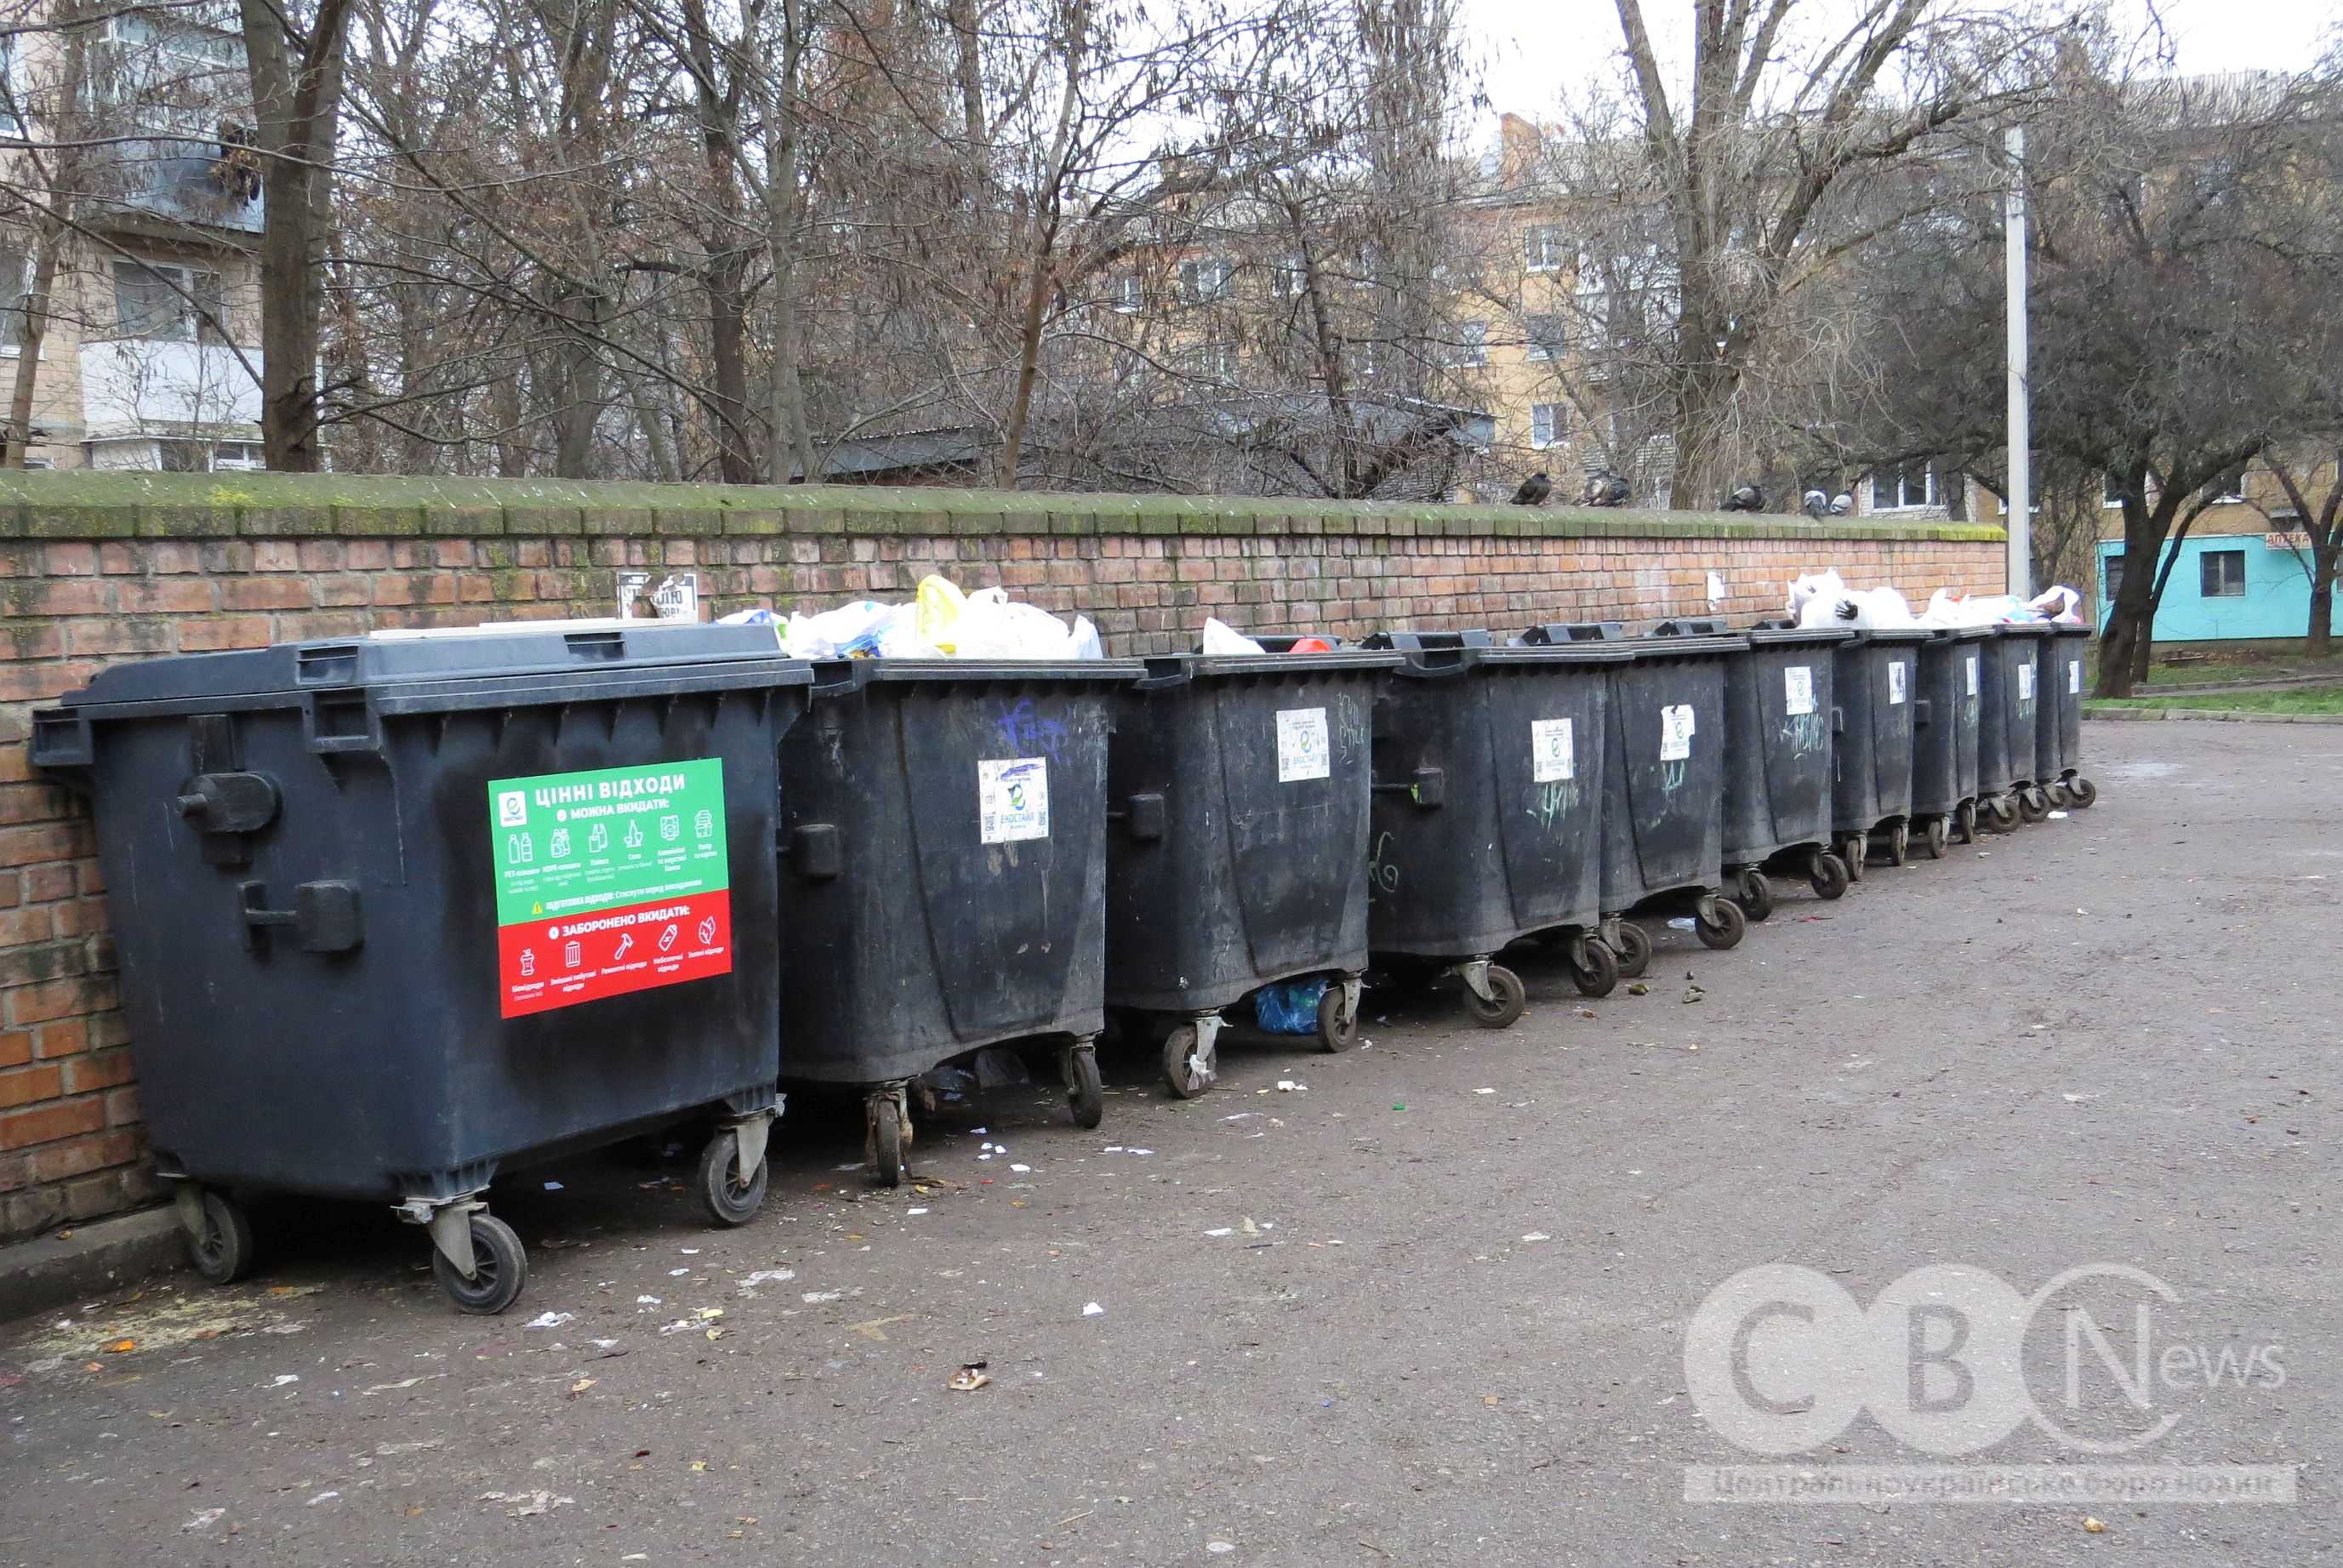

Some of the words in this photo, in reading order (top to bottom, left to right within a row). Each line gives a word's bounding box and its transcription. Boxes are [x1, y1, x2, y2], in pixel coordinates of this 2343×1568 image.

[535, 784, 593, 807] ЦІННІ
[598, 773, 686, 799] ВІДХОДИ
[571, 804, 615, 819] МОЖНА
[617, 798, 670, 814] ВКИДАТИ:
[562, 915, 636, 937] ЗАБОРОНЕНО
[637, 904, 691, 924] ВКИДАТИ:
